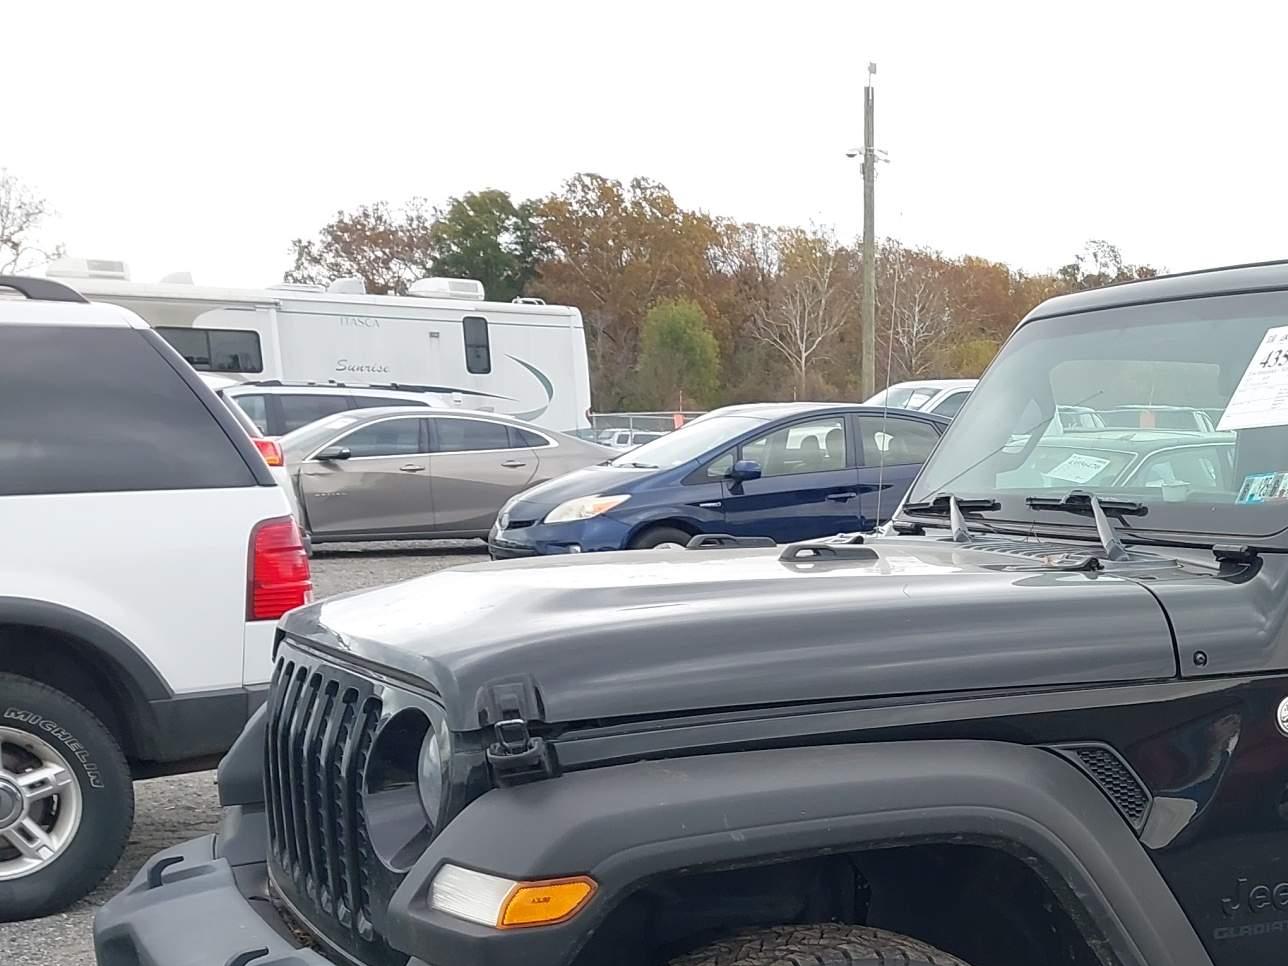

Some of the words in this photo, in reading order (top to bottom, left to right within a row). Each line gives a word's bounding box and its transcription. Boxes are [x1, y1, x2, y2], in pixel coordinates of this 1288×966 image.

[338, 317, 383, 329] ITASCA
[335, 359, 391, 373] Sunrise
[3, 707, 104, 788] MICHELIN
